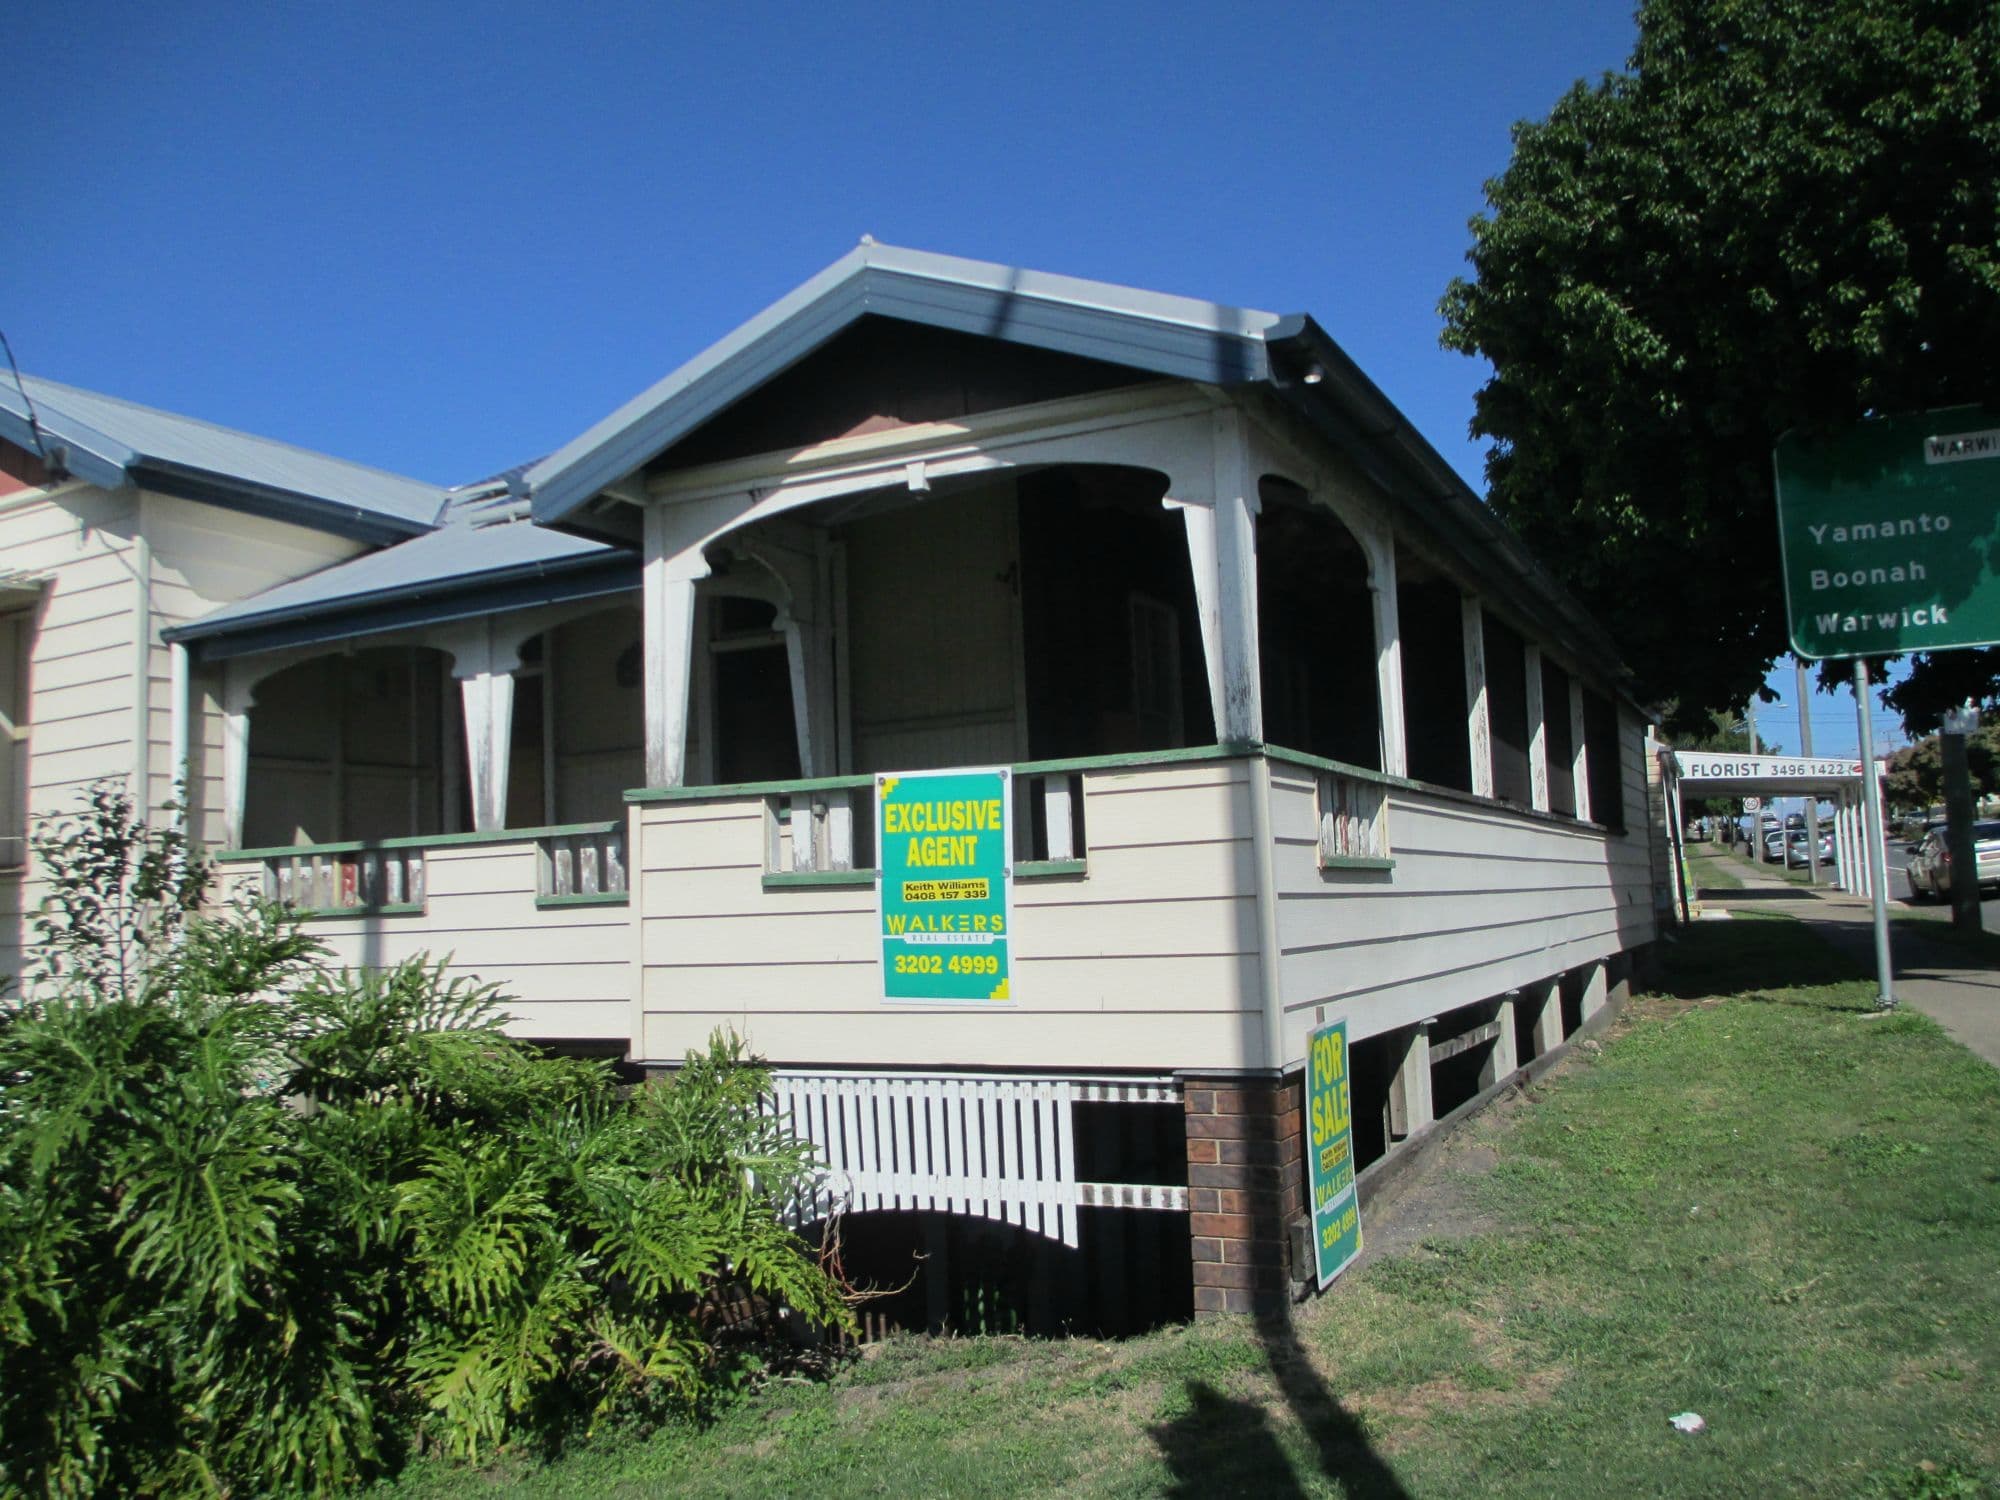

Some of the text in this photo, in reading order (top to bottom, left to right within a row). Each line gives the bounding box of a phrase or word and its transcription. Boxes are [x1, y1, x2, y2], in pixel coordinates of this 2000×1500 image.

[1809, 513, 1951, 545] Yamanto
[1811, 561, 1926, 590] Boonah
[1815, 604, 1948, 635] Warwick
[1691, 763, 1844, 777] FLORIST 3496 1422
[884, 799, 1001, 833] EXCLUSIVE
[906, 835, 978, 867] AGENT
[905, 880, 985, 892] Keith Williams
[905, 889, 987, 901] 0408 157 339
[886, 914, 1004, 936] WALKERS
[894, 955, 999, 975] 3202 4999
[1313, 1031, 1343, 1090] FOR
[1312, 1079, 1349, 1147] SALE
[1322, 1219, 1342, 1249] 3202
